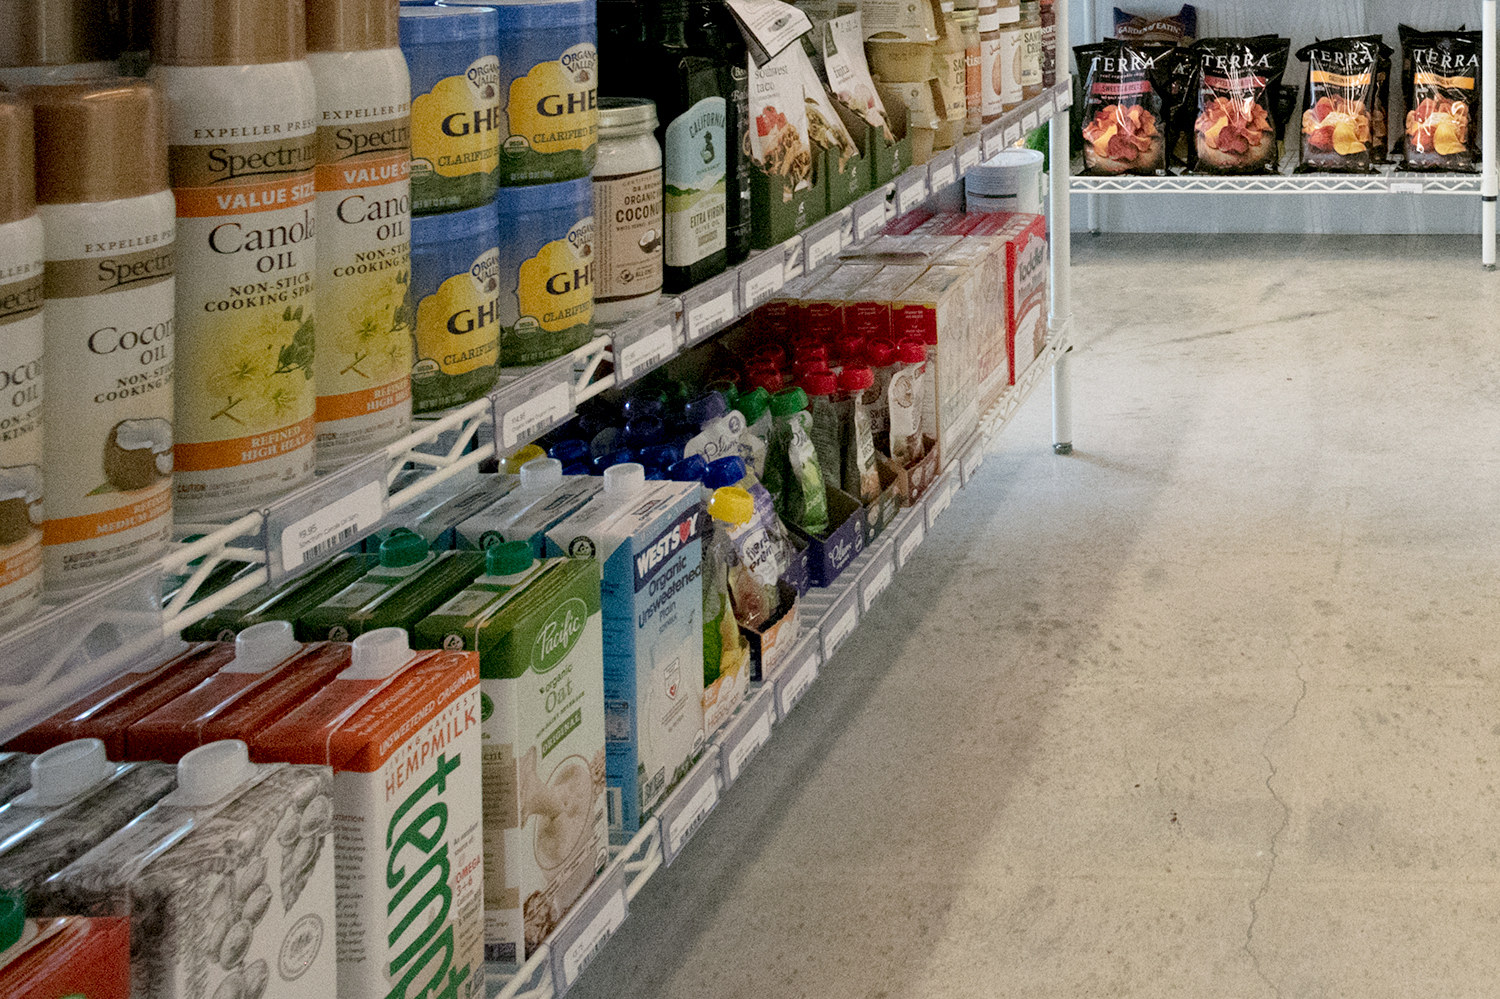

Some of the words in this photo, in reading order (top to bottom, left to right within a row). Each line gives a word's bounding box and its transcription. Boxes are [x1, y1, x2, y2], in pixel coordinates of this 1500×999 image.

[1091, 56, 1156, 73] TERRA
[1202, 54, 1270, 70] TERRA
[1308, 48, 1375, 65] TERRA
[756, 82, 775, 94] taco
[193, 124, 282, 140] EXPELLER
[343, 163, 399, 185] VALUE
[216, 187, 287, 210] VALUE
[690, 211, 707, 228] EXTRA
[376, 221, 405, 241] OIL
[256, 252, 297, 273] OIL
[204, 292, 288, 313] COOKING
[385, 705, 477, 801] HEMPMILK
